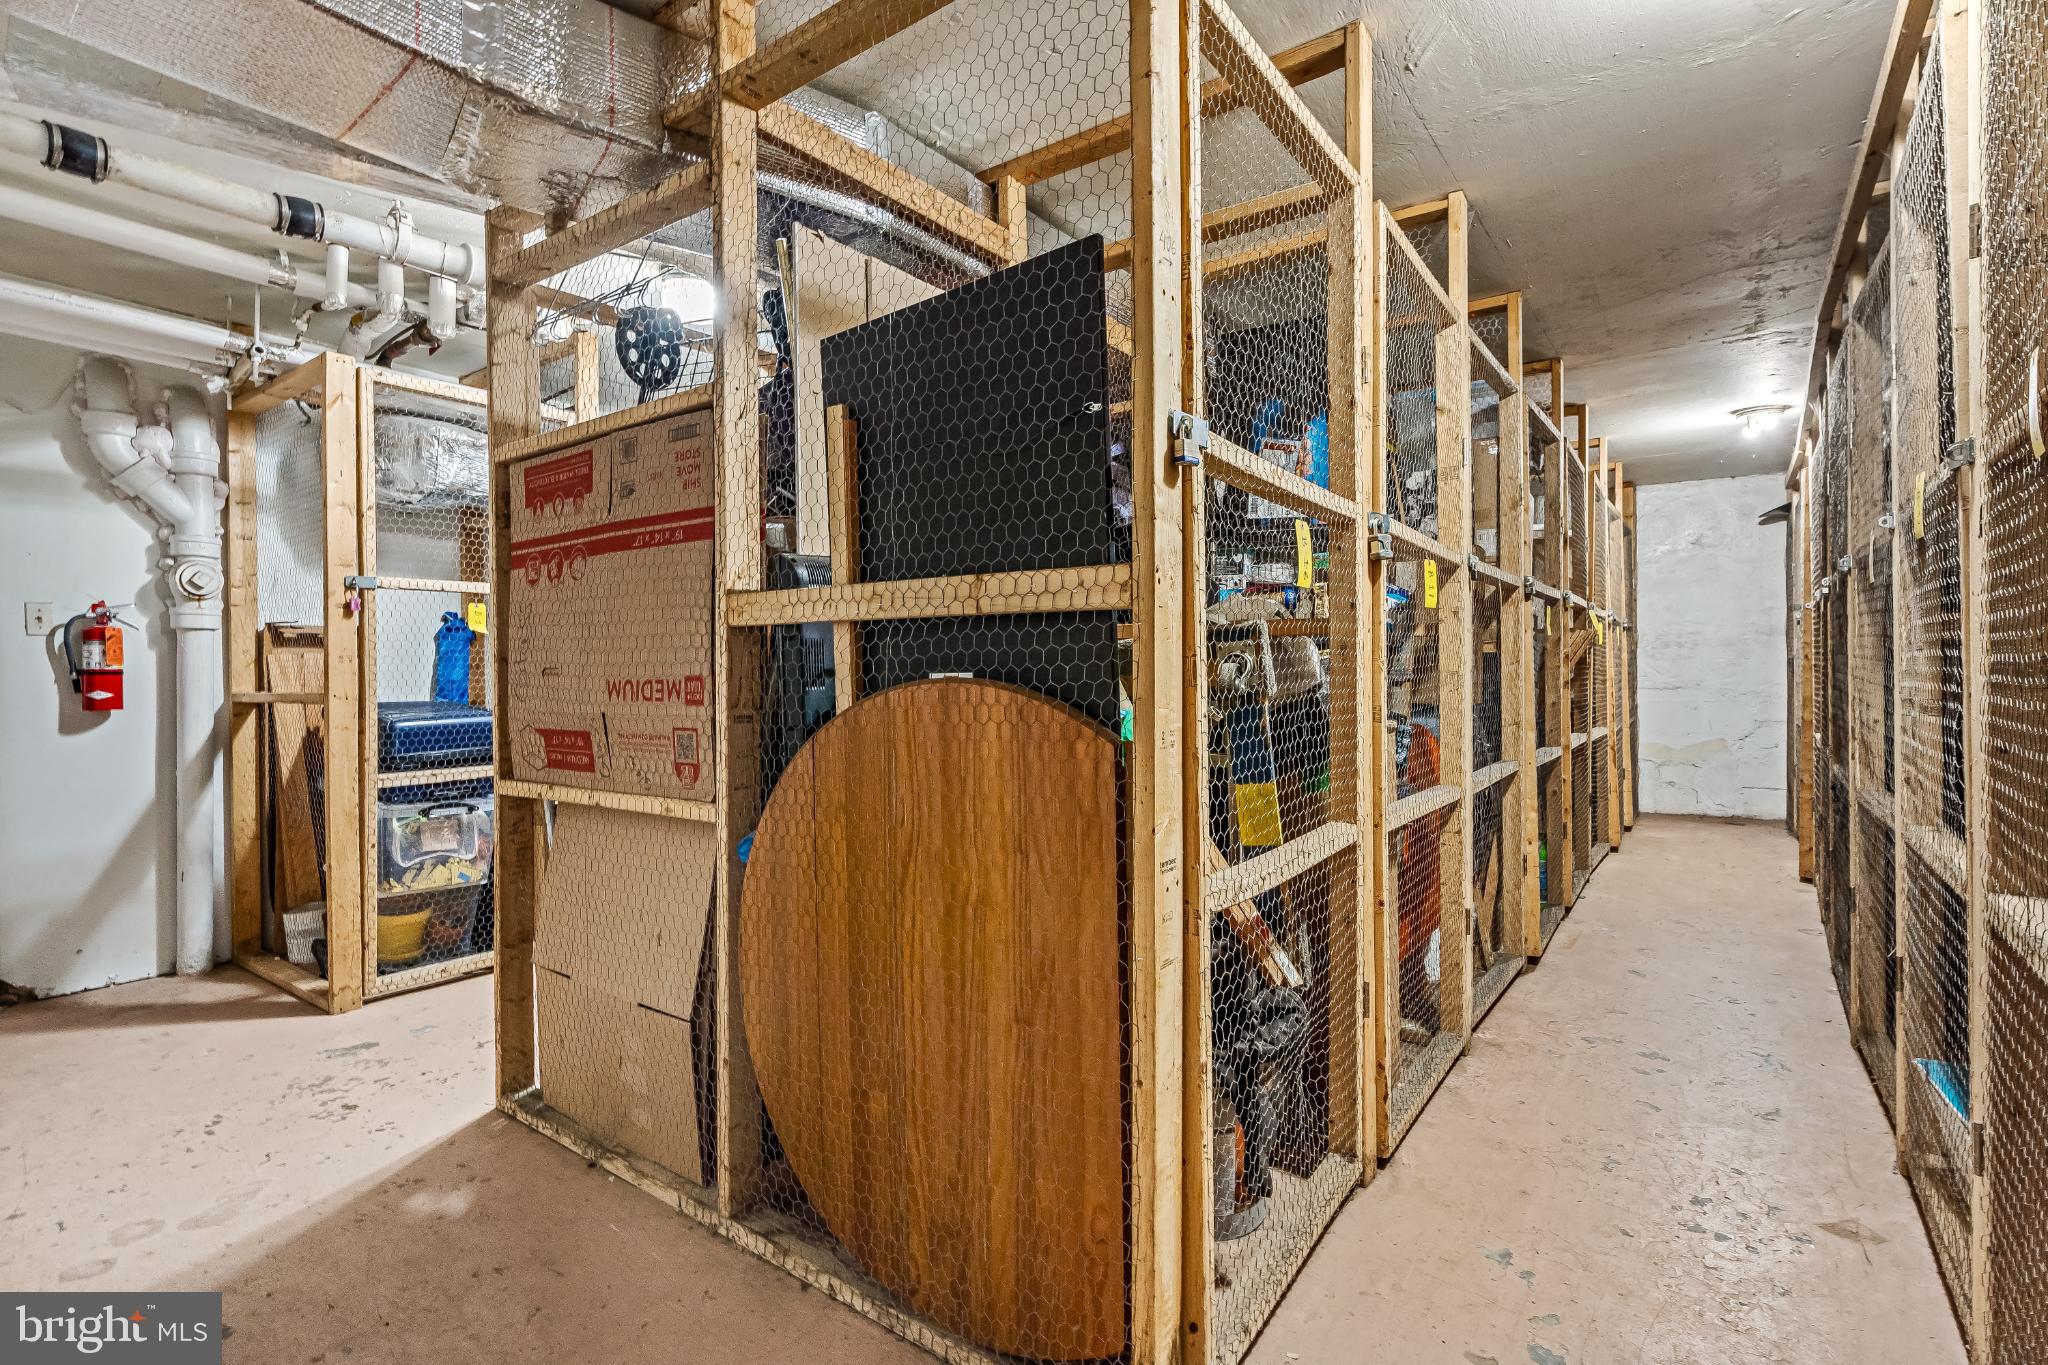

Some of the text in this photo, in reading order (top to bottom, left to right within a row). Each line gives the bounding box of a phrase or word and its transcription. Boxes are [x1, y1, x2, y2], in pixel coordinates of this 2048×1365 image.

[674, 447, 702, 463] STORE
[676, 462, 701, 475] MOVE
[682, 478, 702, 491] SHIP
[607, 679, 682, 703] MEDIUM
